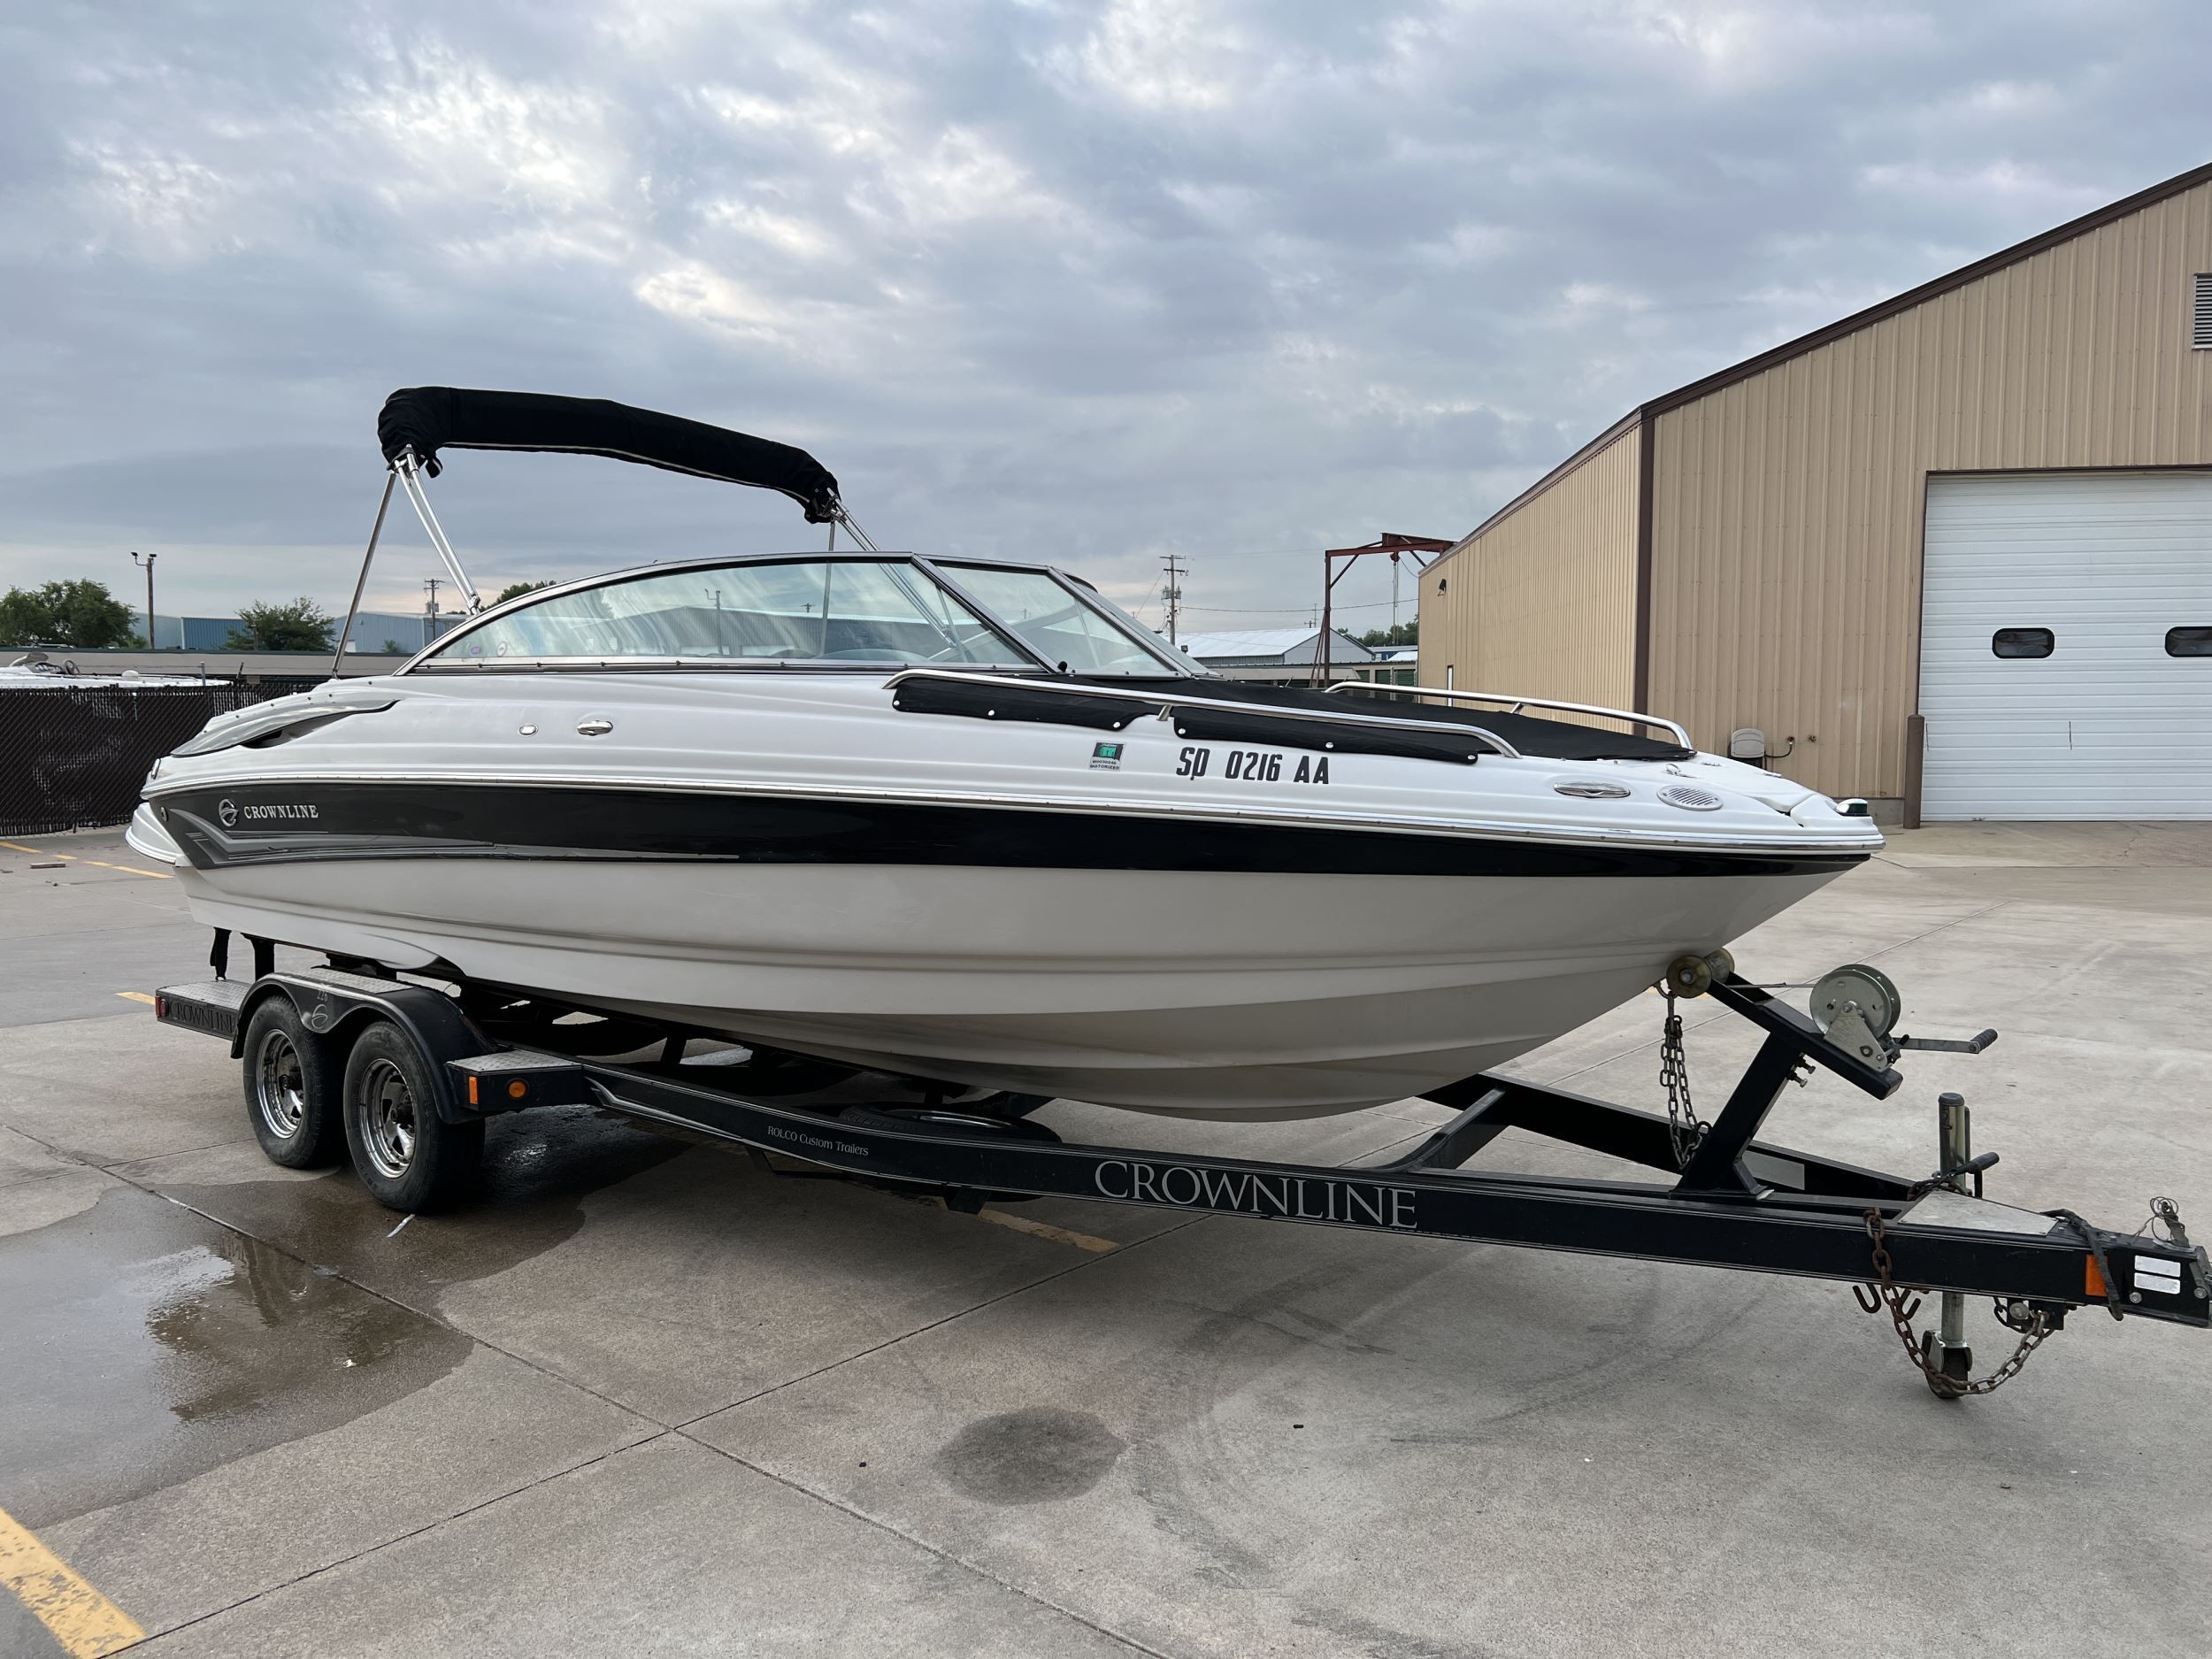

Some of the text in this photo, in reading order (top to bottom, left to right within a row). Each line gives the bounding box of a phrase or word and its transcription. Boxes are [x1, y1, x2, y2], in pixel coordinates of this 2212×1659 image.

[1176, 747, 1329, 784] SD 0216 AA
[243, 804, 319, 819] CROWNLINE
[767, 1125, 869, 1156] ROLCO Custom Trailers
[1094, 1160, 1418, 1230] CROWNLINE
